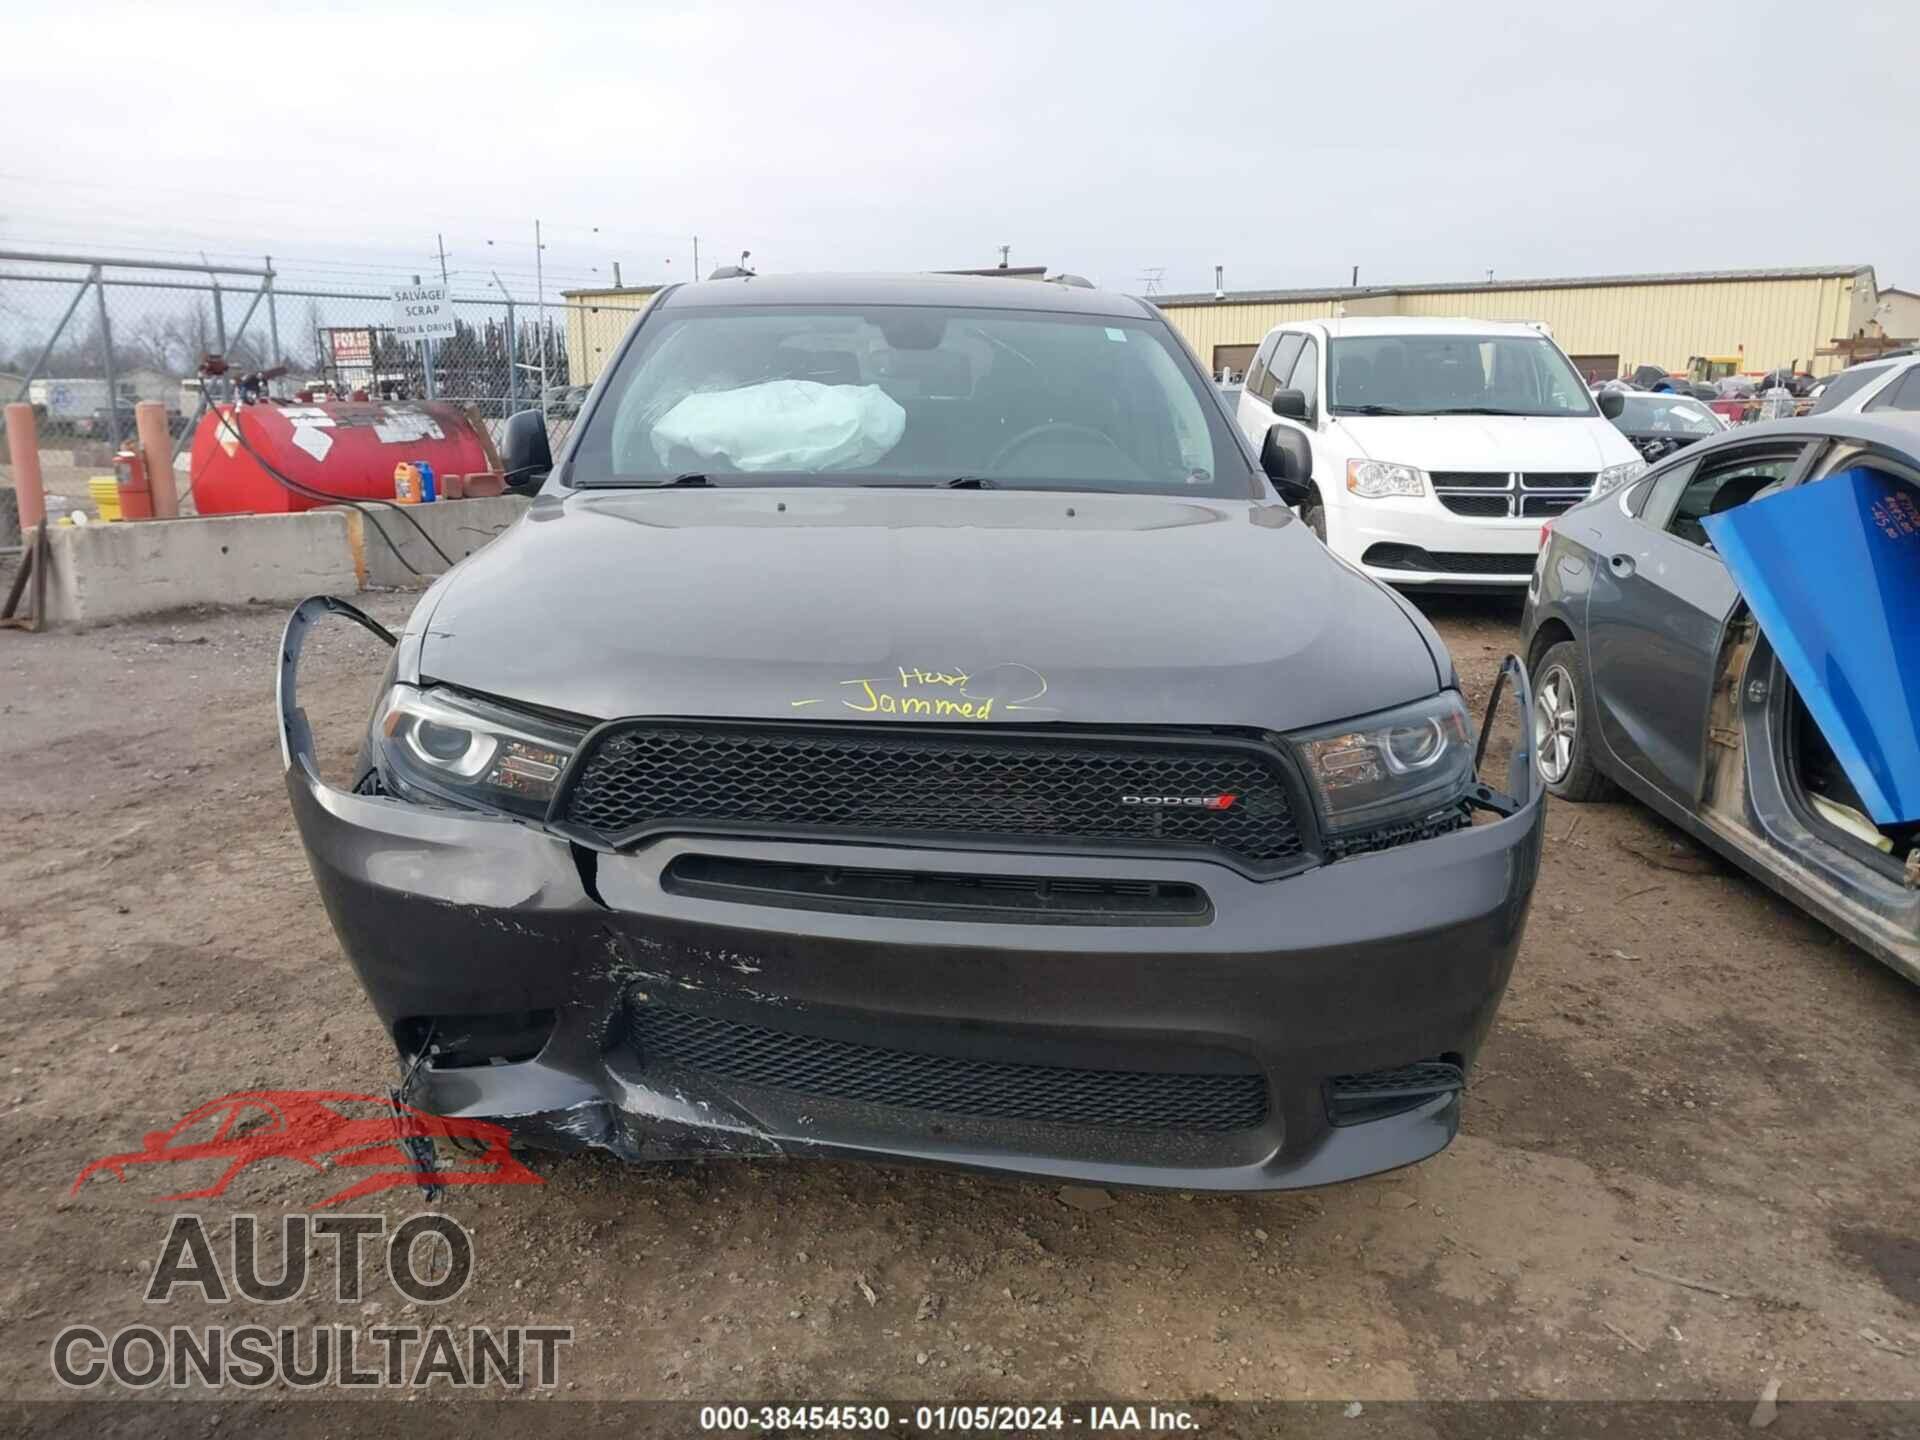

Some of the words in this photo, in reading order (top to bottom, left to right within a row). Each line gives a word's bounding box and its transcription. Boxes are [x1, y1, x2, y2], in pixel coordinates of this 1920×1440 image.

[405, 304, 440, 317] SCRAP
[396, 325, 416, 335] RUN
[418, 324, 425, 334] &
[426, 322, 453, 333] DRIVE
[1122, 795, 1220, 808] DODGE
